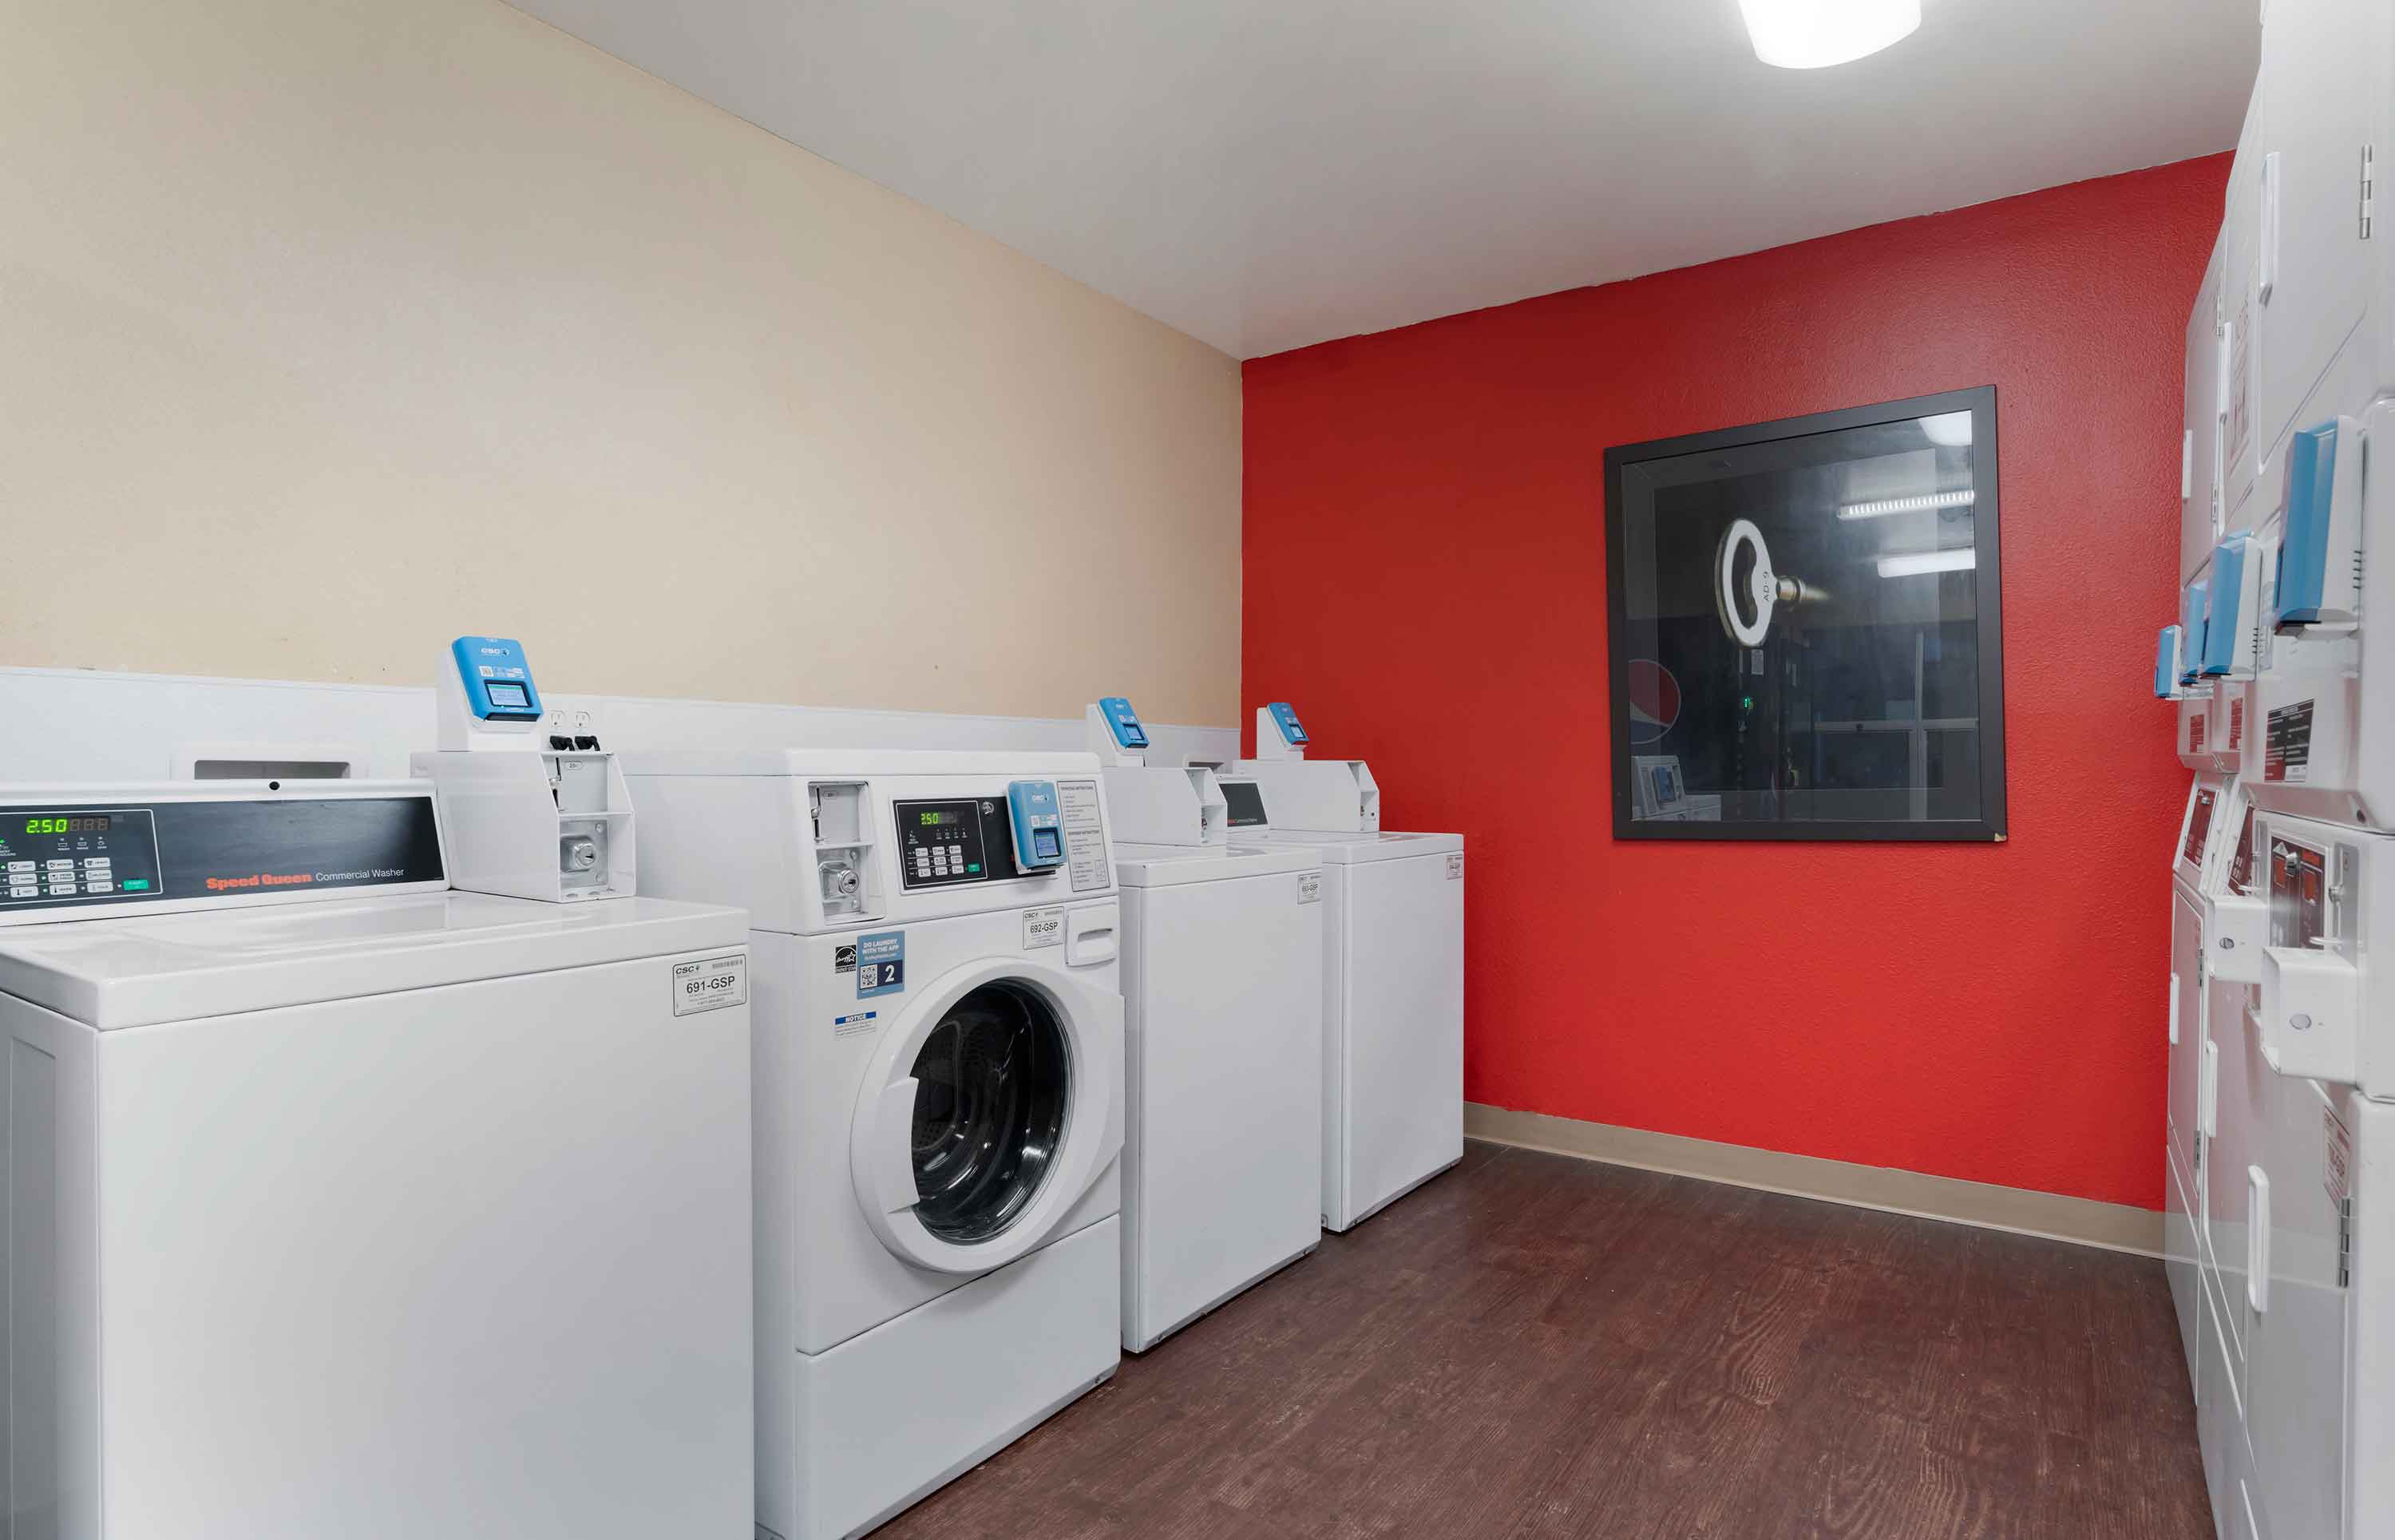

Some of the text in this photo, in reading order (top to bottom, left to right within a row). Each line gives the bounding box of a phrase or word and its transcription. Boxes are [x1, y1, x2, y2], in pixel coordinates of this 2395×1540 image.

[26, 818, 68, 834] 2.50
[206, 868, 404, 890] Speed Queen Commercial Washer
[1030, 921, 1059, 933] 692-GSP
[675, 965, 695, 975] CSC
[885, 964, 895, 983] 2
[686, 976, 735, 994] 691-GSP
